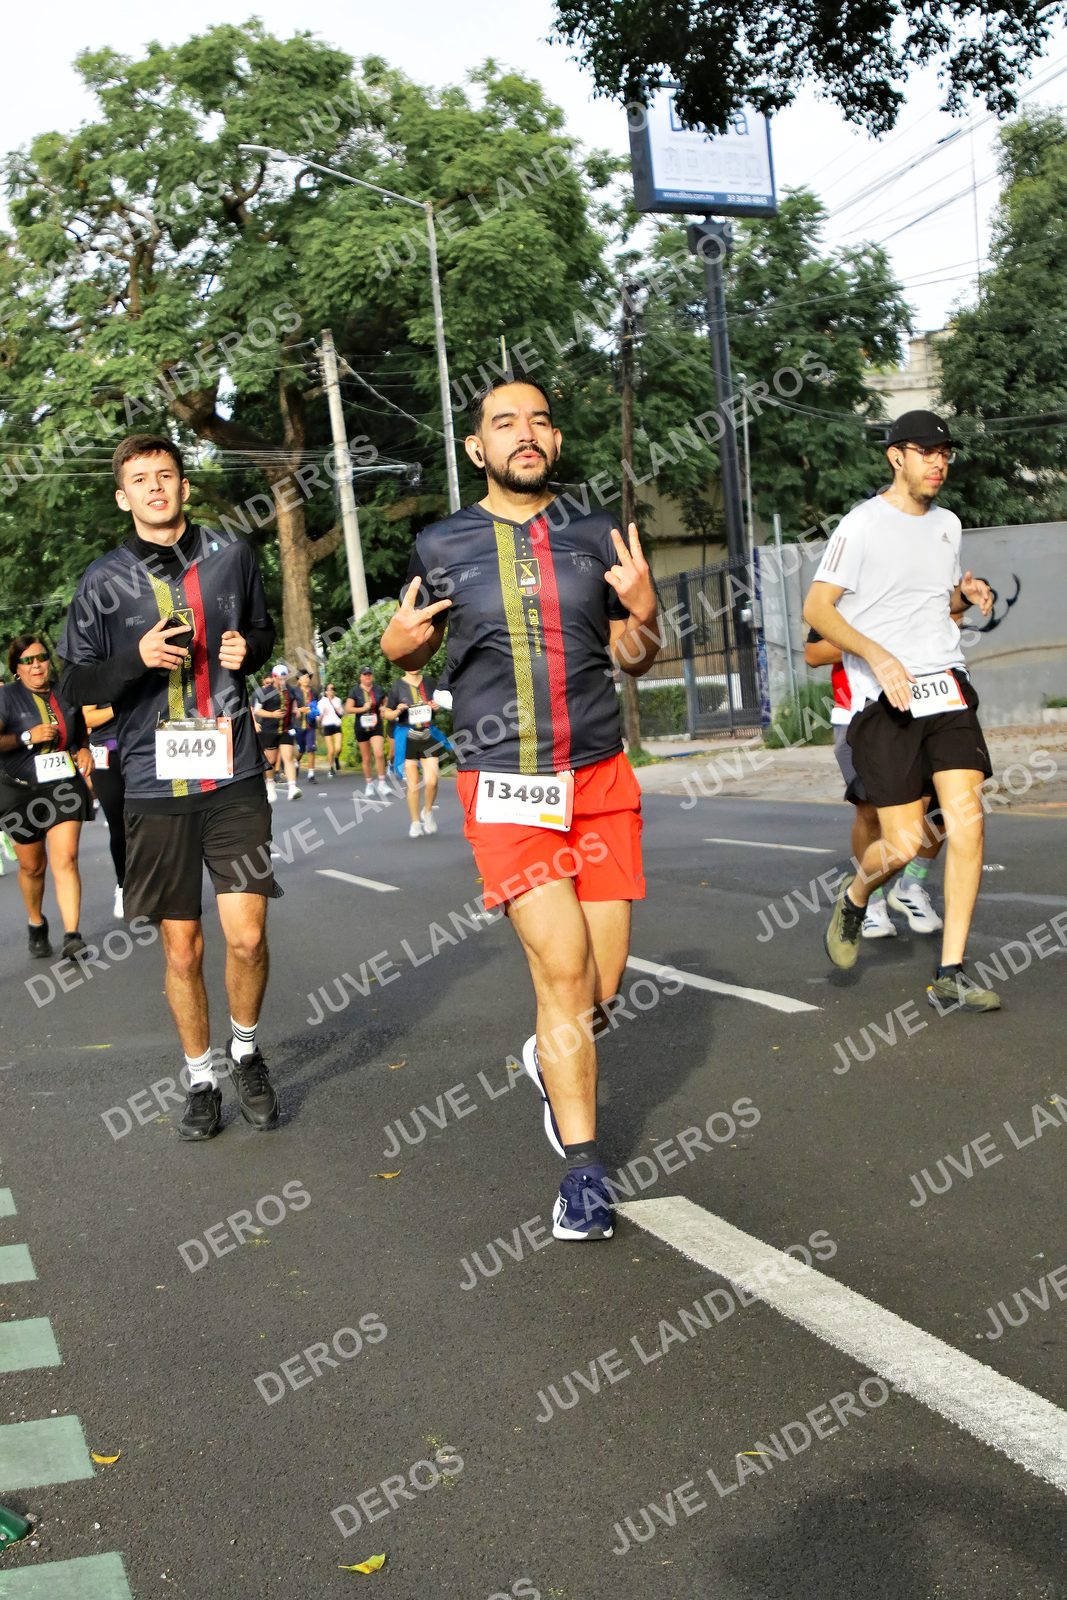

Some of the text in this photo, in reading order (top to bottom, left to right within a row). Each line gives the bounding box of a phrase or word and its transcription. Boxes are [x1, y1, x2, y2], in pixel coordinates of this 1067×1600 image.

[912, 680, 949, 700] 8510
[166, 738, 216, 758] 8449
[42, 755, 67, 769] 7734
[484, 779, 561, 806] 13498
